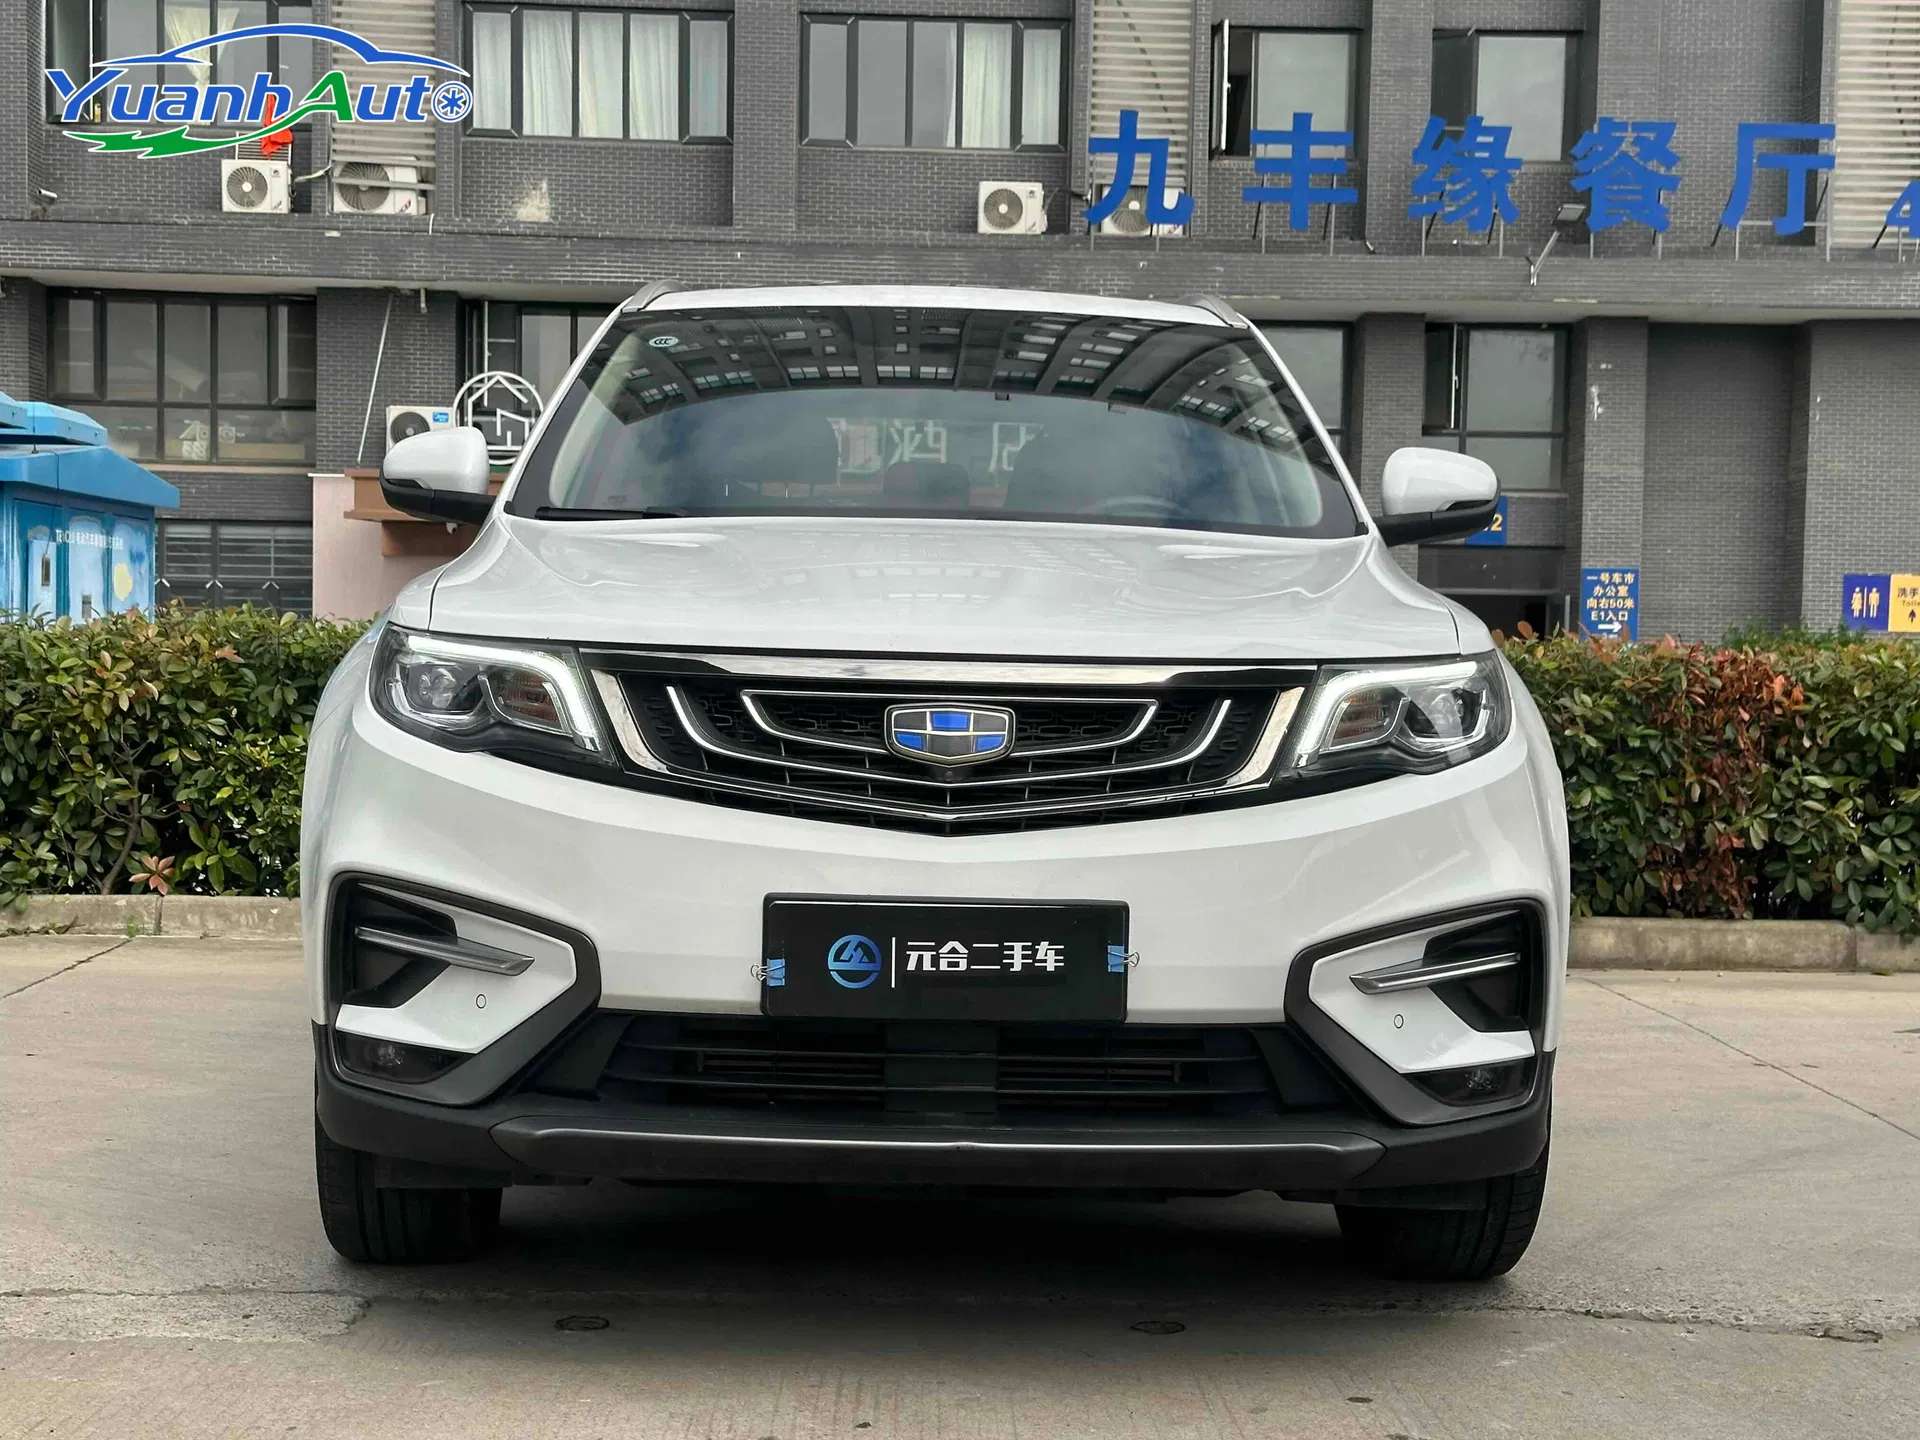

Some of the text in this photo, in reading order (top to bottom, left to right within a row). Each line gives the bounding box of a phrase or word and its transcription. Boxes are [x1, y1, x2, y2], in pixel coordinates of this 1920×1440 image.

[1085, 109, 1836, 236] 九丰缘餐厅
[1586, 572, 1635, 584] 一号车市
[1593, 584, 1629, 597] 办公室
[1586, 597, 1635, 610] 向右50米
[1591, 610, 1629, 621] E1入口
[906, 940, 1065, 972] 元合二手车
